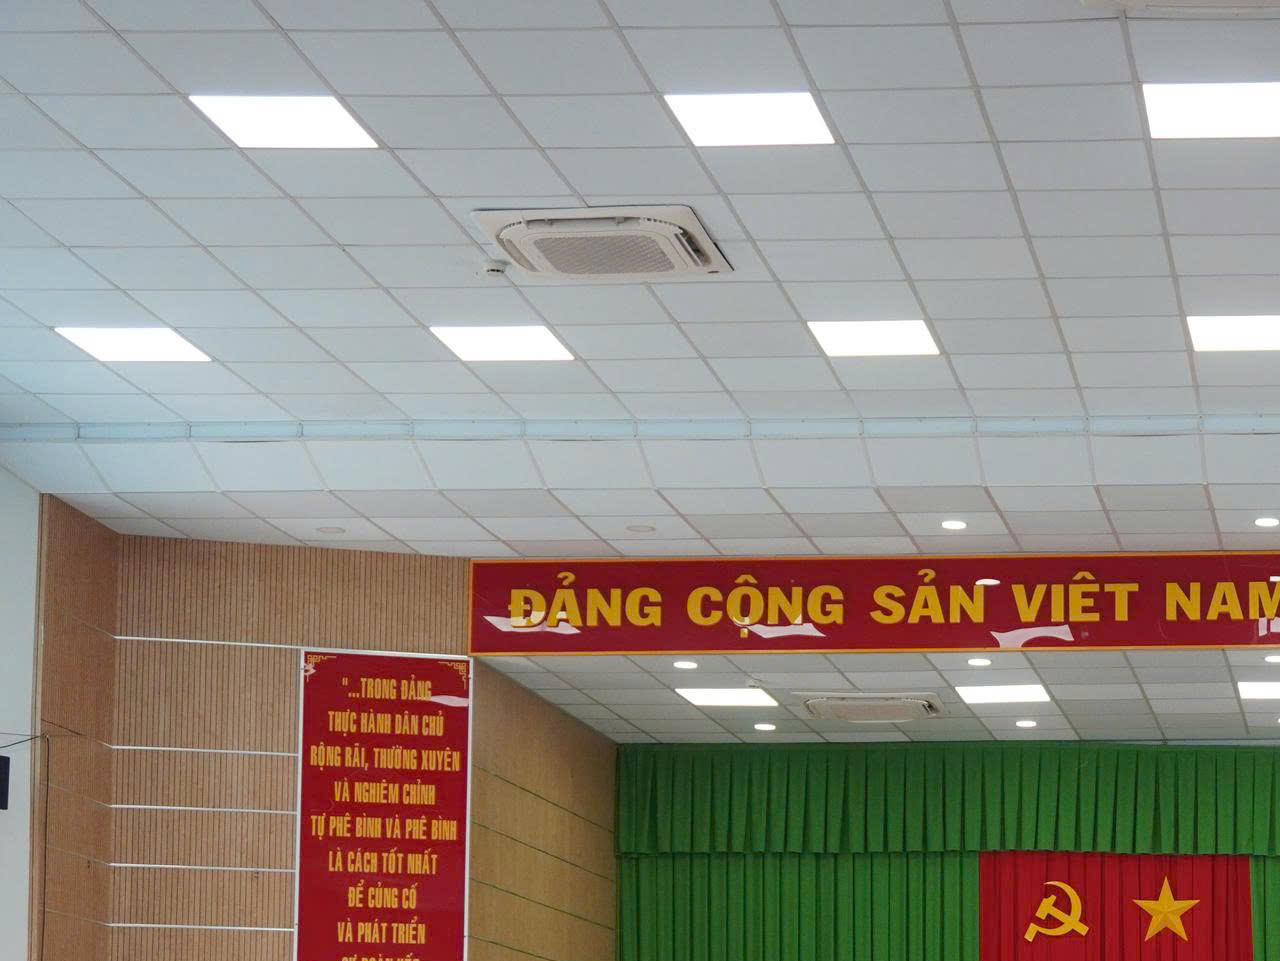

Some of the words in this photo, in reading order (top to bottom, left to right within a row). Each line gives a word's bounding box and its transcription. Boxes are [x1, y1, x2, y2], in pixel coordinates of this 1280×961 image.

[507, 571, 663, 627] ĐẢNG
[686, 574, 845, 638] CỘNG
[869, 568, 985, 624] SẢN
[401, 674, 433, 700] ĐẢNG
[328, 708, 357, 736] THỰC
[360, 708, 392, 734] HÀNH
[394, 710, 419, 735] DÂN
[421, 710, 444, 736] CHỦ
[310, 741, 341, 771] RỘNG
[373, 745, 417, 770] THƯỜNG
[421, 747, 461, 771] XUYÊN
[334, 777, 350, 802] VÀ
[354, 779, 399, 803] NGHIÊM
[403, 778, 436, 805] CHỈNH
[311, 812, 326, 840] TỰ
[329, 812, 351, 837] PHÊ
[355, 812, 382, 838] BÌNH
[385, 814, 401, 839] VÀ
[405, 815, 427, 840] PHÊ
[431, 815, 457, 840] BÌNH
[328, 847, 343, 872] LÀ
[347, 847, 378, 873] CÁCH
[382, 846, 404, 874] TỐT
[407, 848, 438, 874] NHẤT
[348, 879, 365, 907] ĐỂ
[368, 881, 399, 909] CỦNG
[402, 882, 418, 909] CỐ
[337, 917, 353, 943] VÀ
[357, 918, 388, 944] PHÁT
[391, 915, 426, 944] TRIỂN
